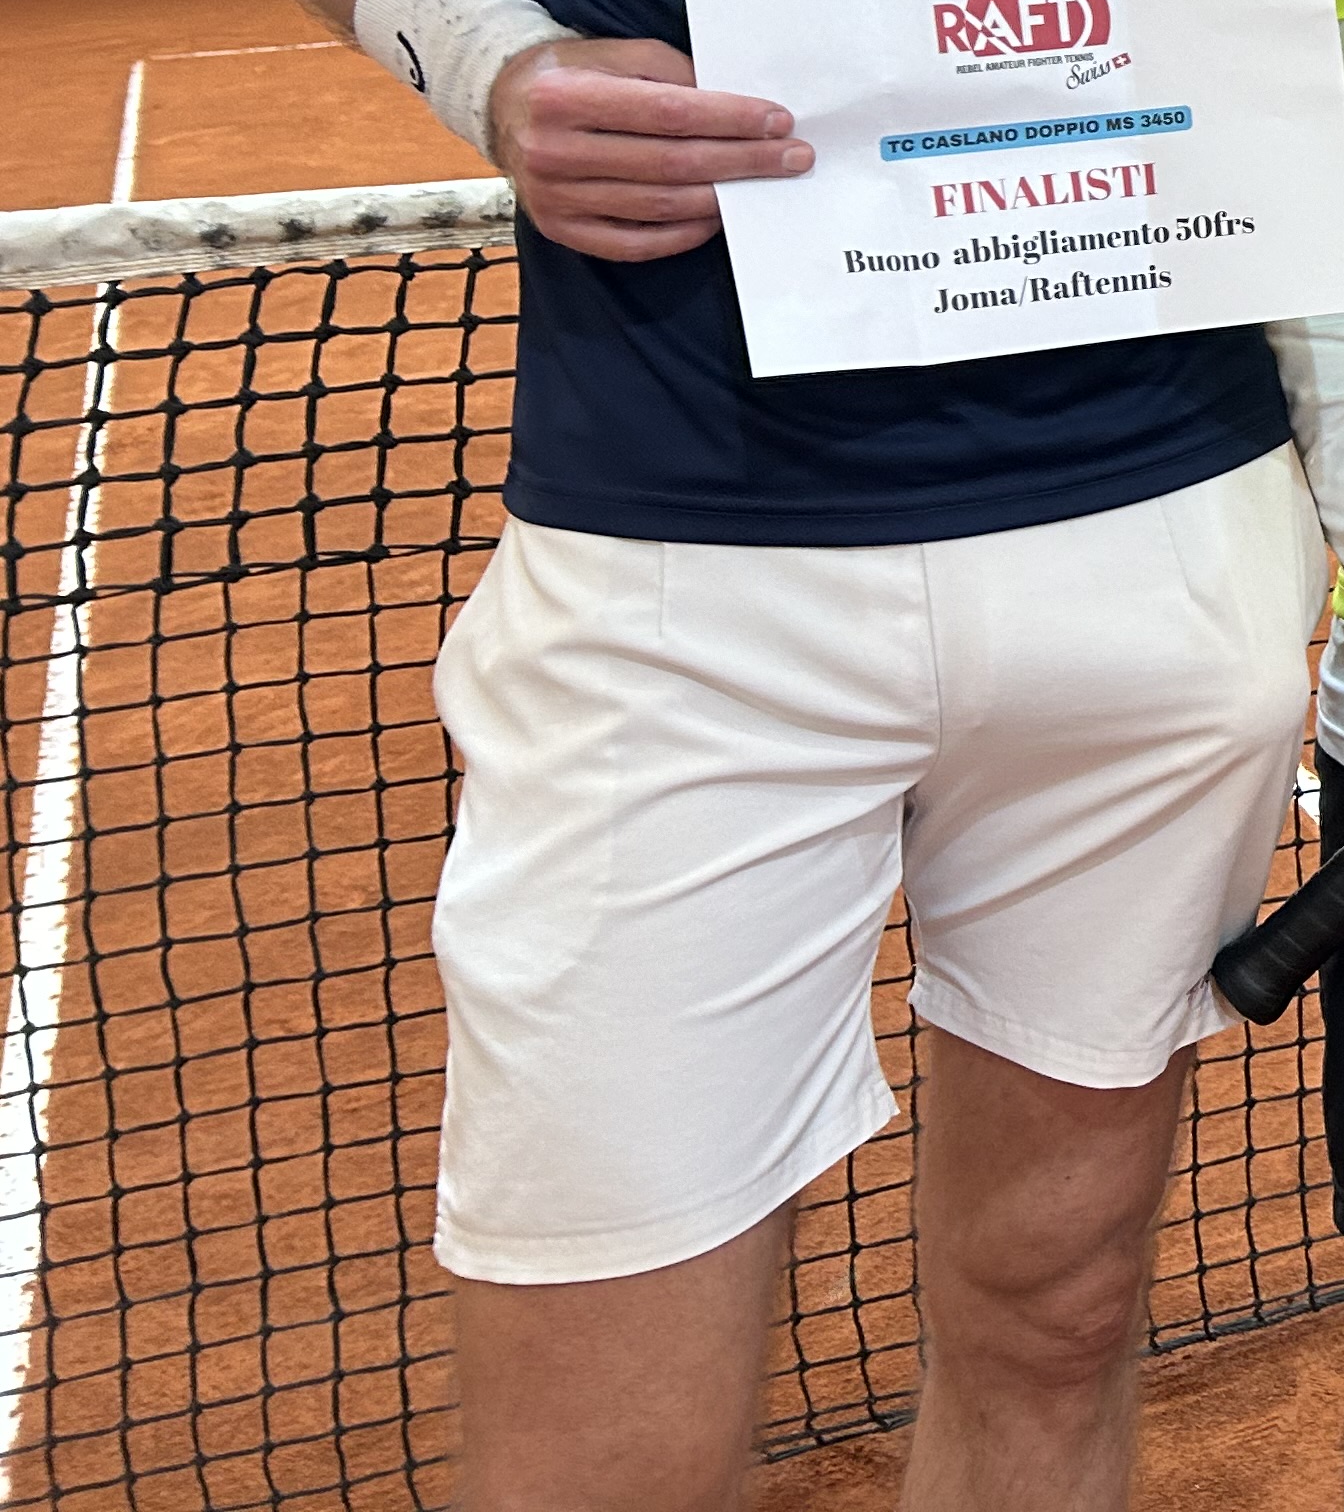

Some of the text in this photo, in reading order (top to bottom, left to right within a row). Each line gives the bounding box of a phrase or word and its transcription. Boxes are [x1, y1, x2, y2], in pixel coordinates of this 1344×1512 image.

[956, 53, 1094, 74] REBEL AMATEUR FIGHTER TENNIS
[1066, 60, 1111, 89] Swiss
[888, 111, 1185, 154] TC CASLANO DOPPIO MS 3450
[930, 162, 1158, 218] FINALISTI
[843, 210, 1256, 274] Buono abbigliamento 50frs
[933, 264, 1172, 314] Joma/Raftennis
